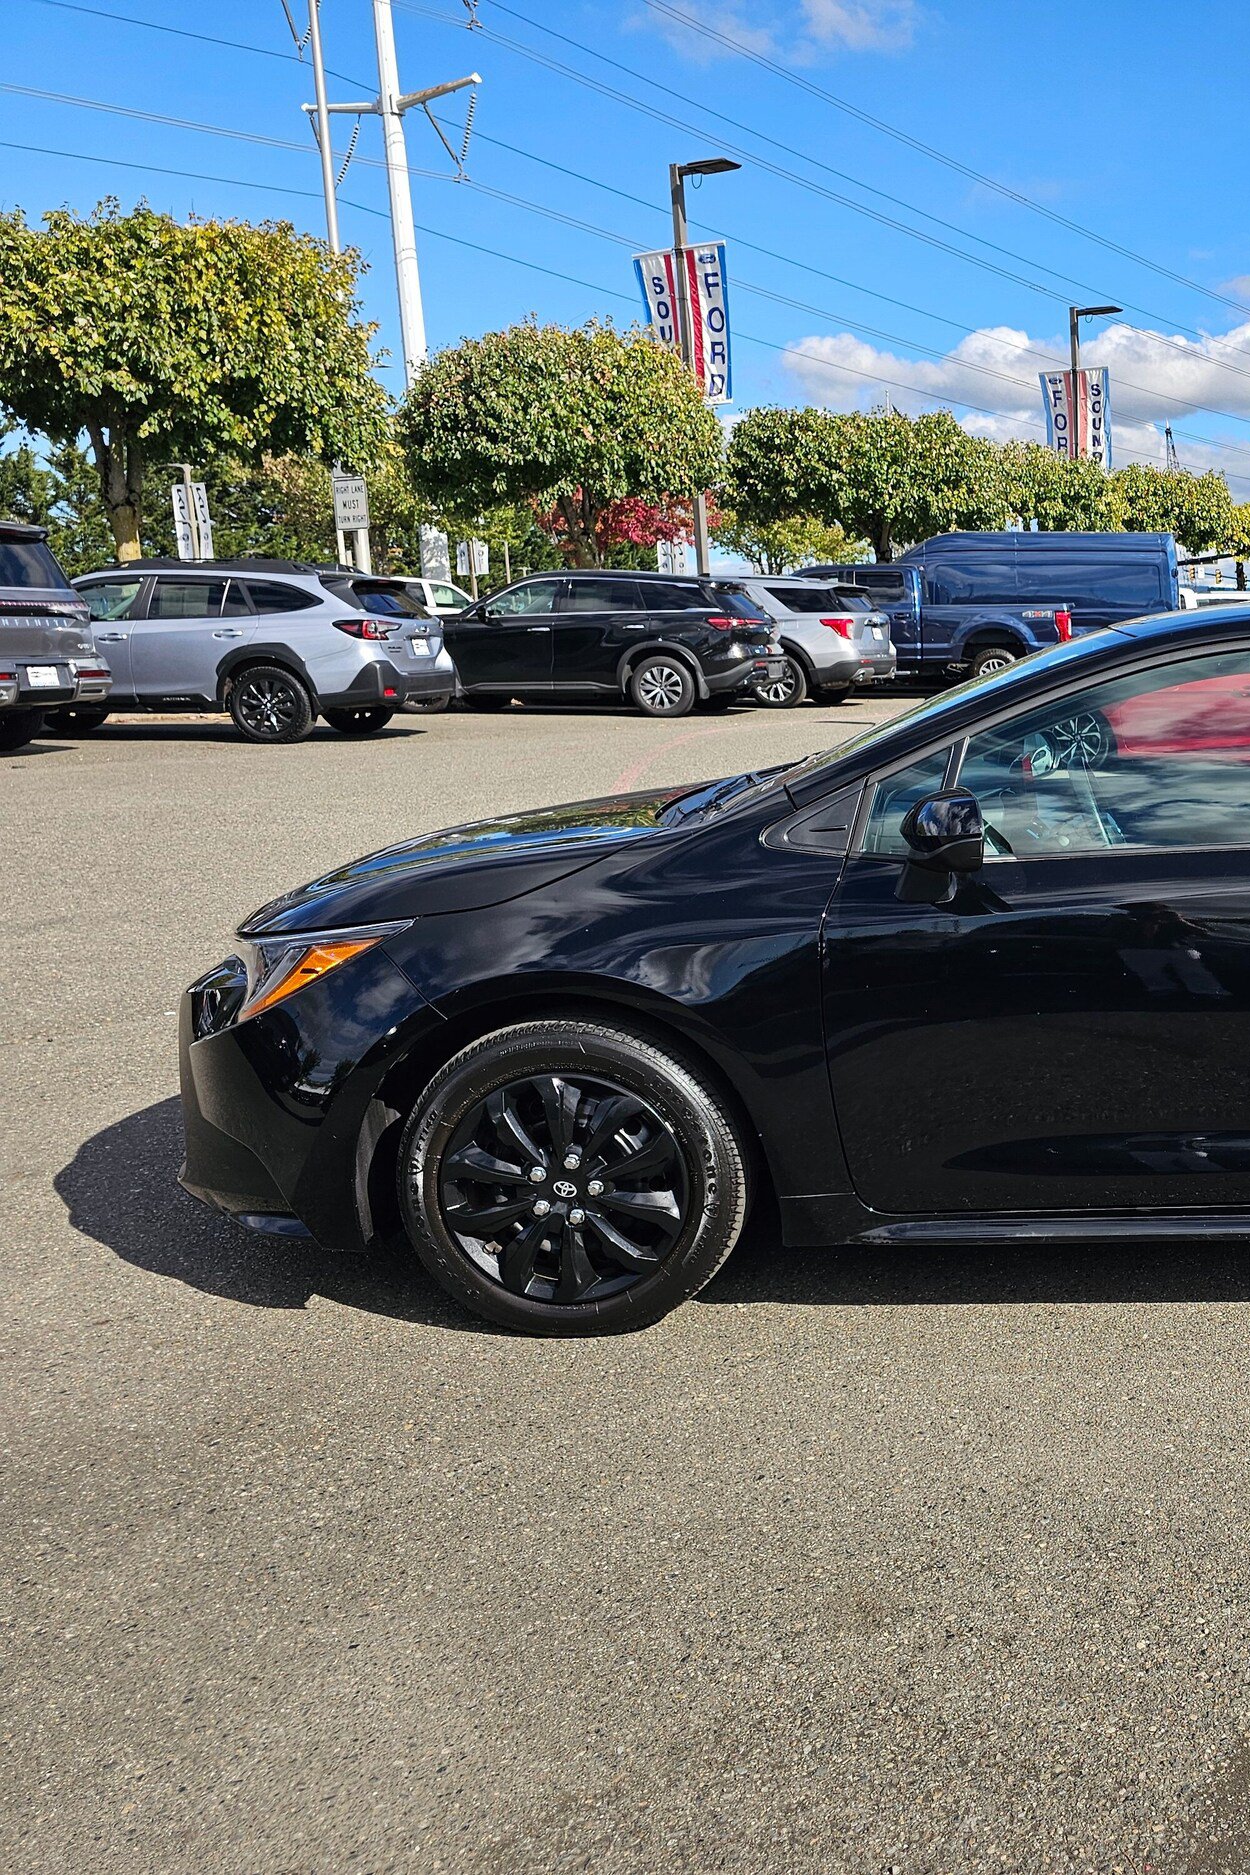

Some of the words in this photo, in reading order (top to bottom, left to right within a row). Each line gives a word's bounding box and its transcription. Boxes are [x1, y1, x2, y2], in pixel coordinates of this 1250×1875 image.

[652, 276, 672, 343] SOU
[704, 272, 725, 397] FORD
[1052, 390, 1068, 454] FOR
[342, 500, 359, 509] MUST
[351, 485, 364, 494] LANE
[1, 618, 68, 627] NFINITI
